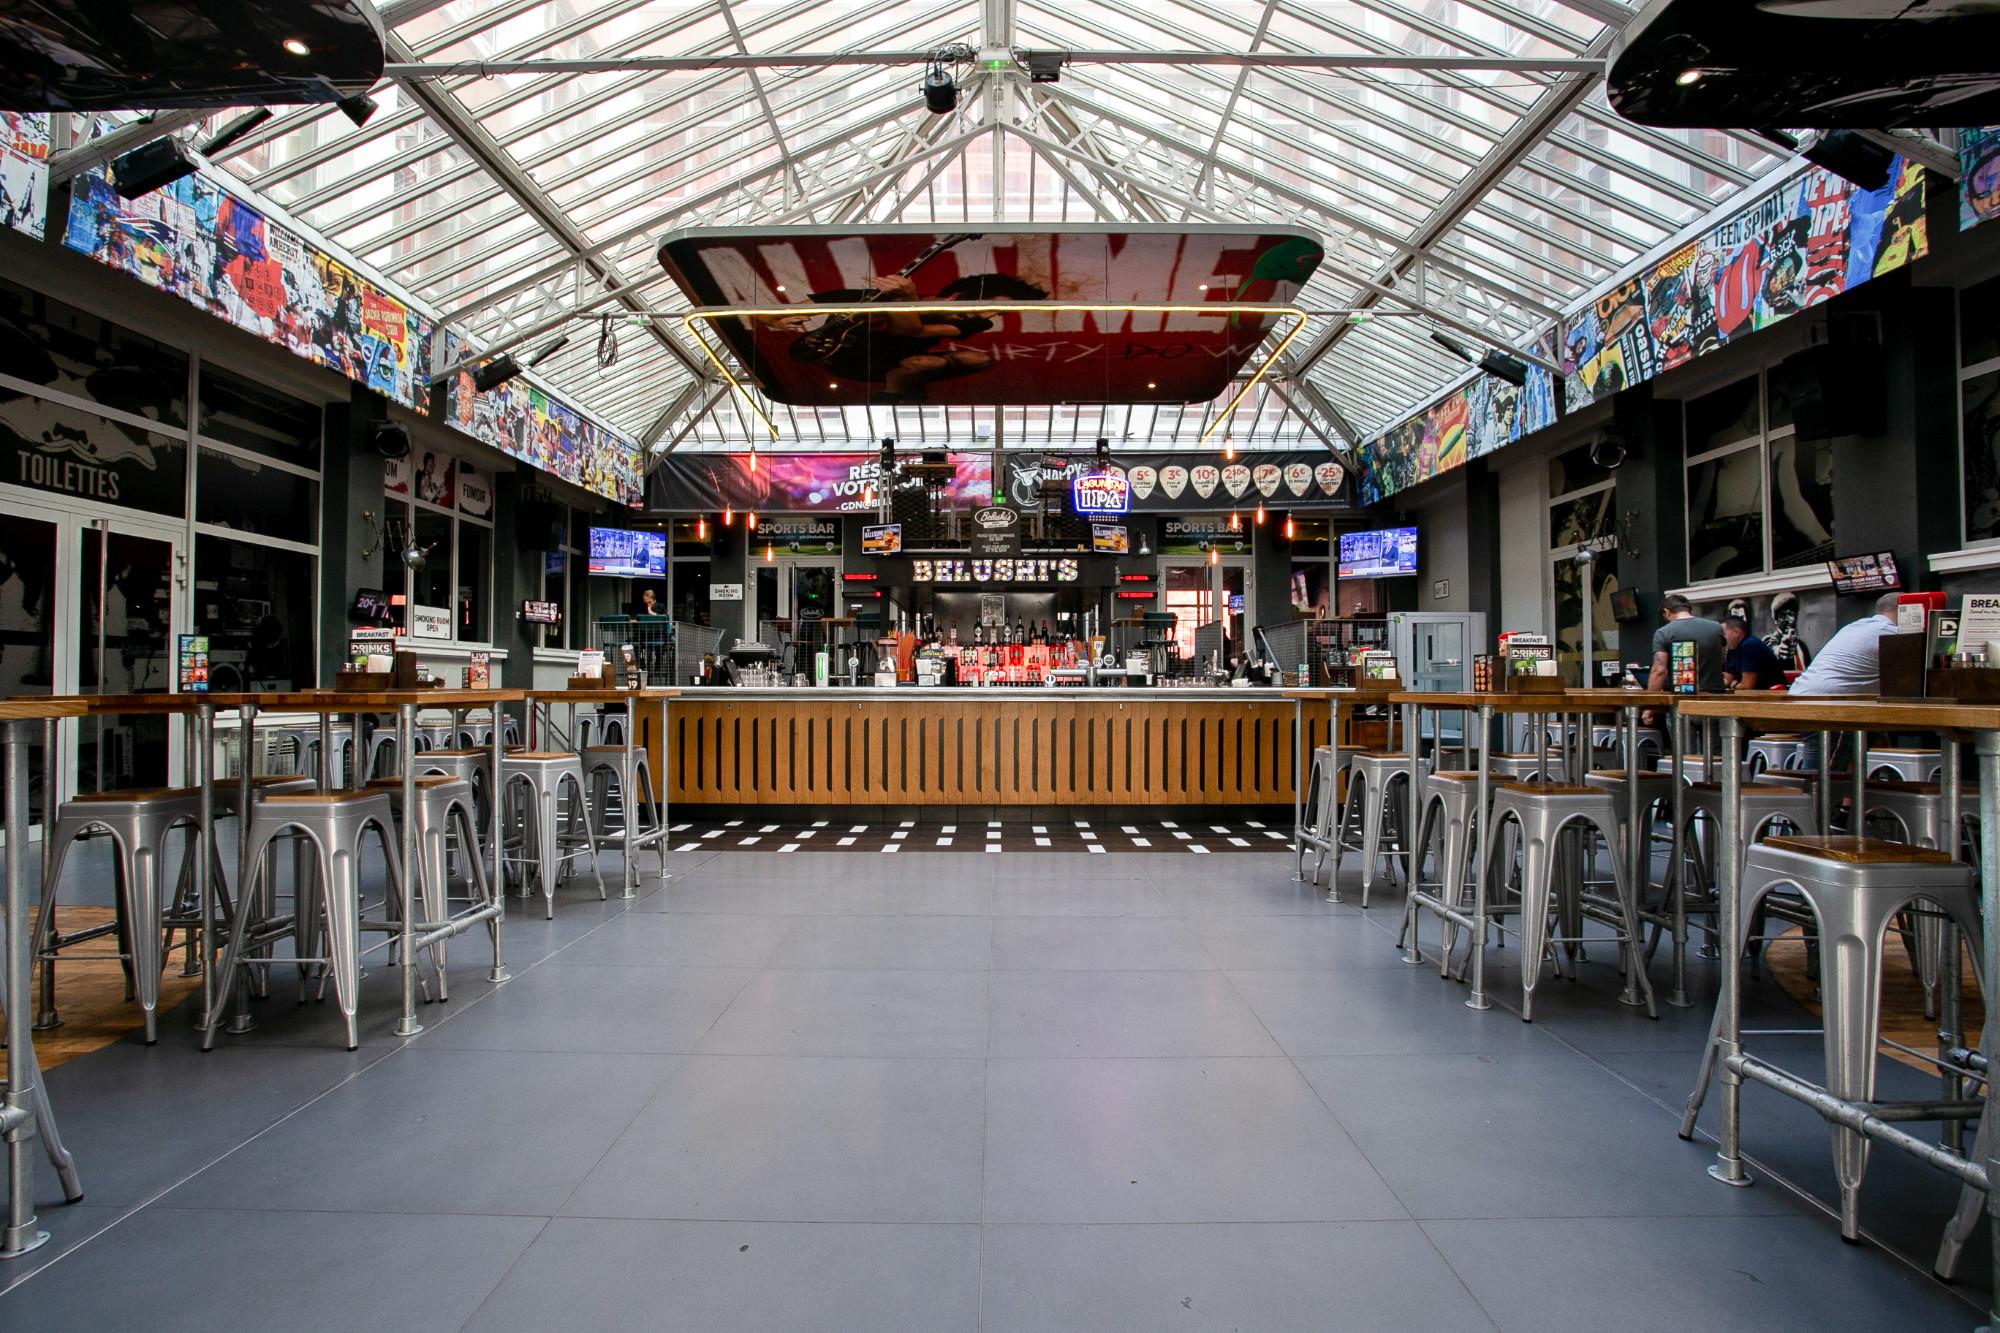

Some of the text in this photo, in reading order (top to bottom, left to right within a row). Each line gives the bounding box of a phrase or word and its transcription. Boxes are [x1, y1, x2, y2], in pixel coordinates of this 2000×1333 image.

[1714, 190, 1784, 248] TEEN SPIRIT
[1770, 228, 1796, 262] ROCK
[1635, 323, 1655, 381] oasis
[17, 450, 119, 500] TOILETTES
[463, 483, 486, 504] FUMOIR
[832, 478, 888, 497] VOTR
[1081, 489, 1122, 508] IPA
[757, 523, 835, 534] SPORTS BAR
[1165, 521, 1244, 533] SPORTS BAR
[912, 559, 1079, 582] BELUSHI'S
[1970, 599, 2000, 608] BREA
[414, 614, 450, 625] SMOKING ROOM
[426, 623, 439, 633] OPEN
[351, 644, 391, 654] DRINKS
[1511, 649, 1549, 658] DRINKS
[628, 680, 638, 689] 19
